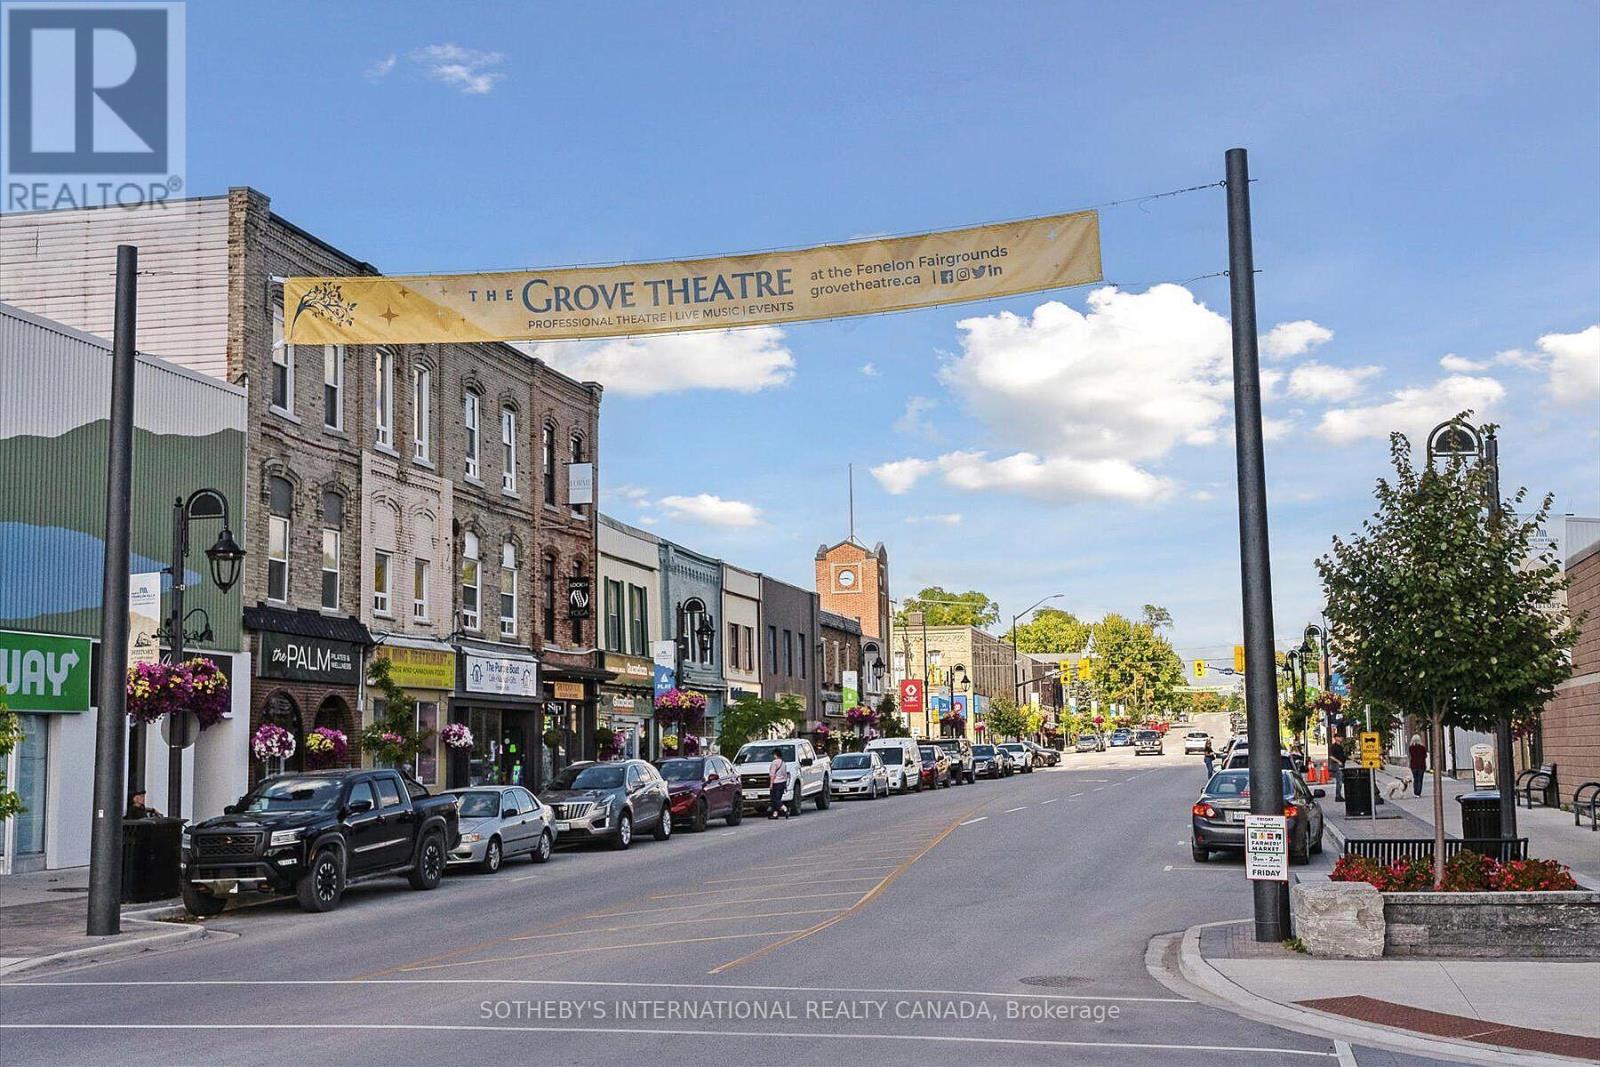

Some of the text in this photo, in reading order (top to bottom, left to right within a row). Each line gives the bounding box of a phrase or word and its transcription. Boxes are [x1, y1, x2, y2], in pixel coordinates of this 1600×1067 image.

[810, 245, 1008, 281] at the Fenelon Fairgrounds
[469, 268, 794, 313] THE GROVE THEATRE
[810, 274, 921, 298] grovetheatre.ca
[528, 302, 794, 329] PROFESSIONAL THEATRE LIVE MUSIC EVENTS
[272, 644, 331, 672] the PALM
[1252, 869, 1281, 877] FRIDAY
